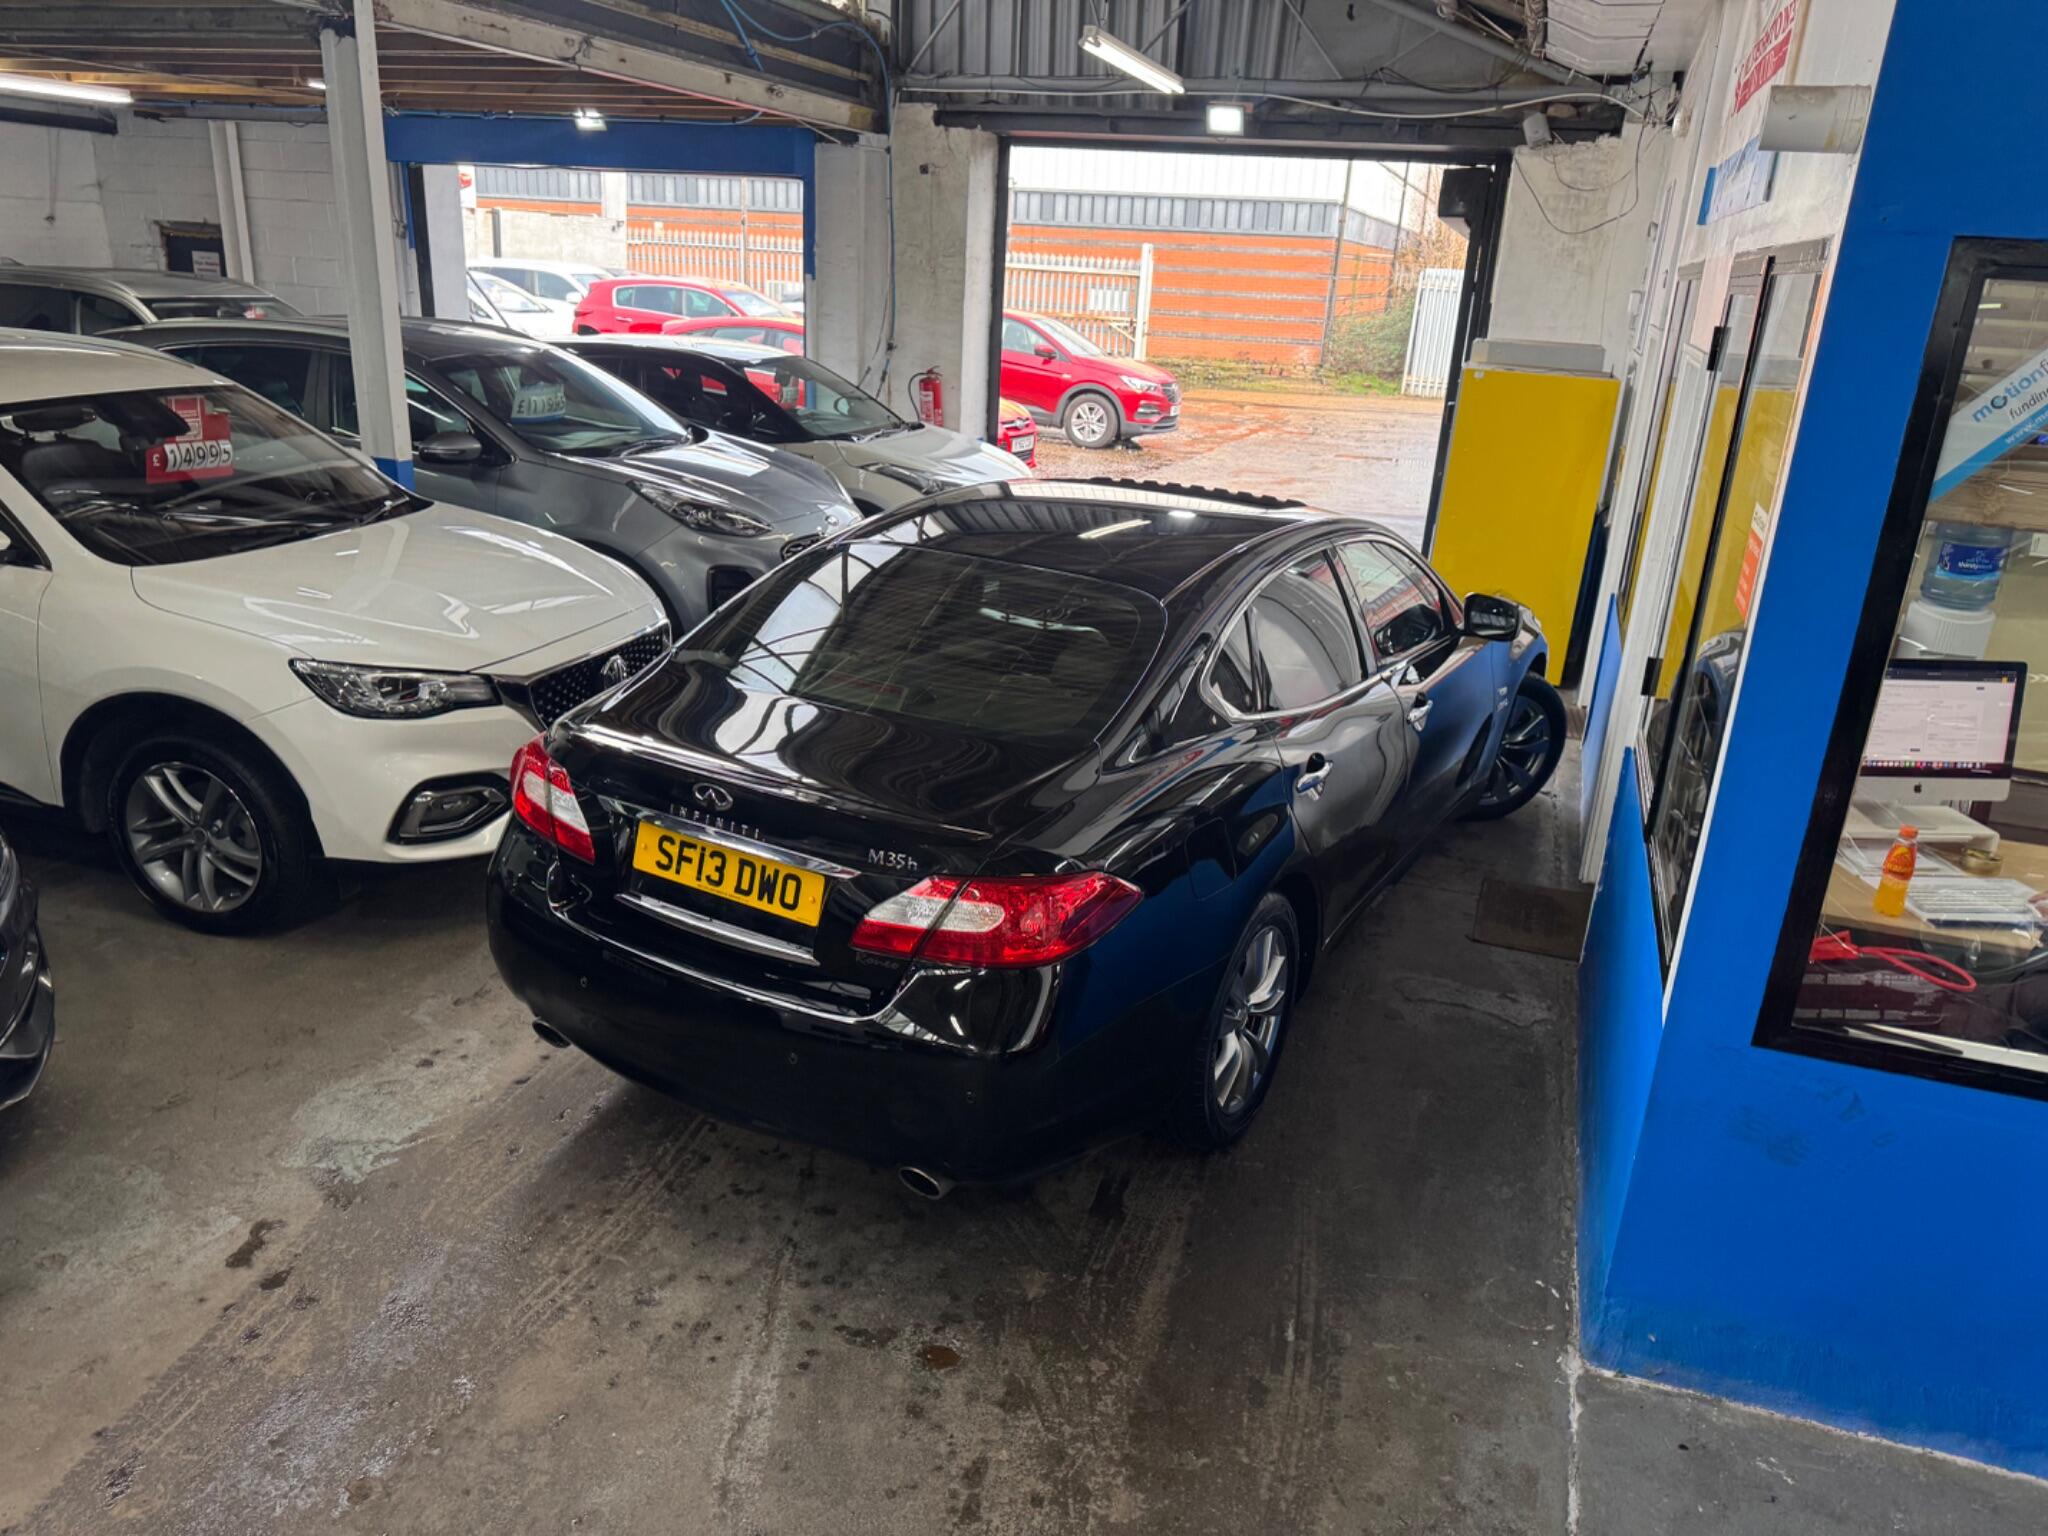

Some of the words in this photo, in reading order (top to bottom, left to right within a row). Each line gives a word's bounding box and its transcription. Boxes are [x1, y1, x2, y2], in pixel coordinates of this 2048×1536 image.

[2009, 387, 2048, 420] fundin
[670, 803, 760, 840] INFINITI
[655, 834, 727, 888] SF13
[734, 858, 802, 911] DWO
[868, 848, 918, 871] M35h
